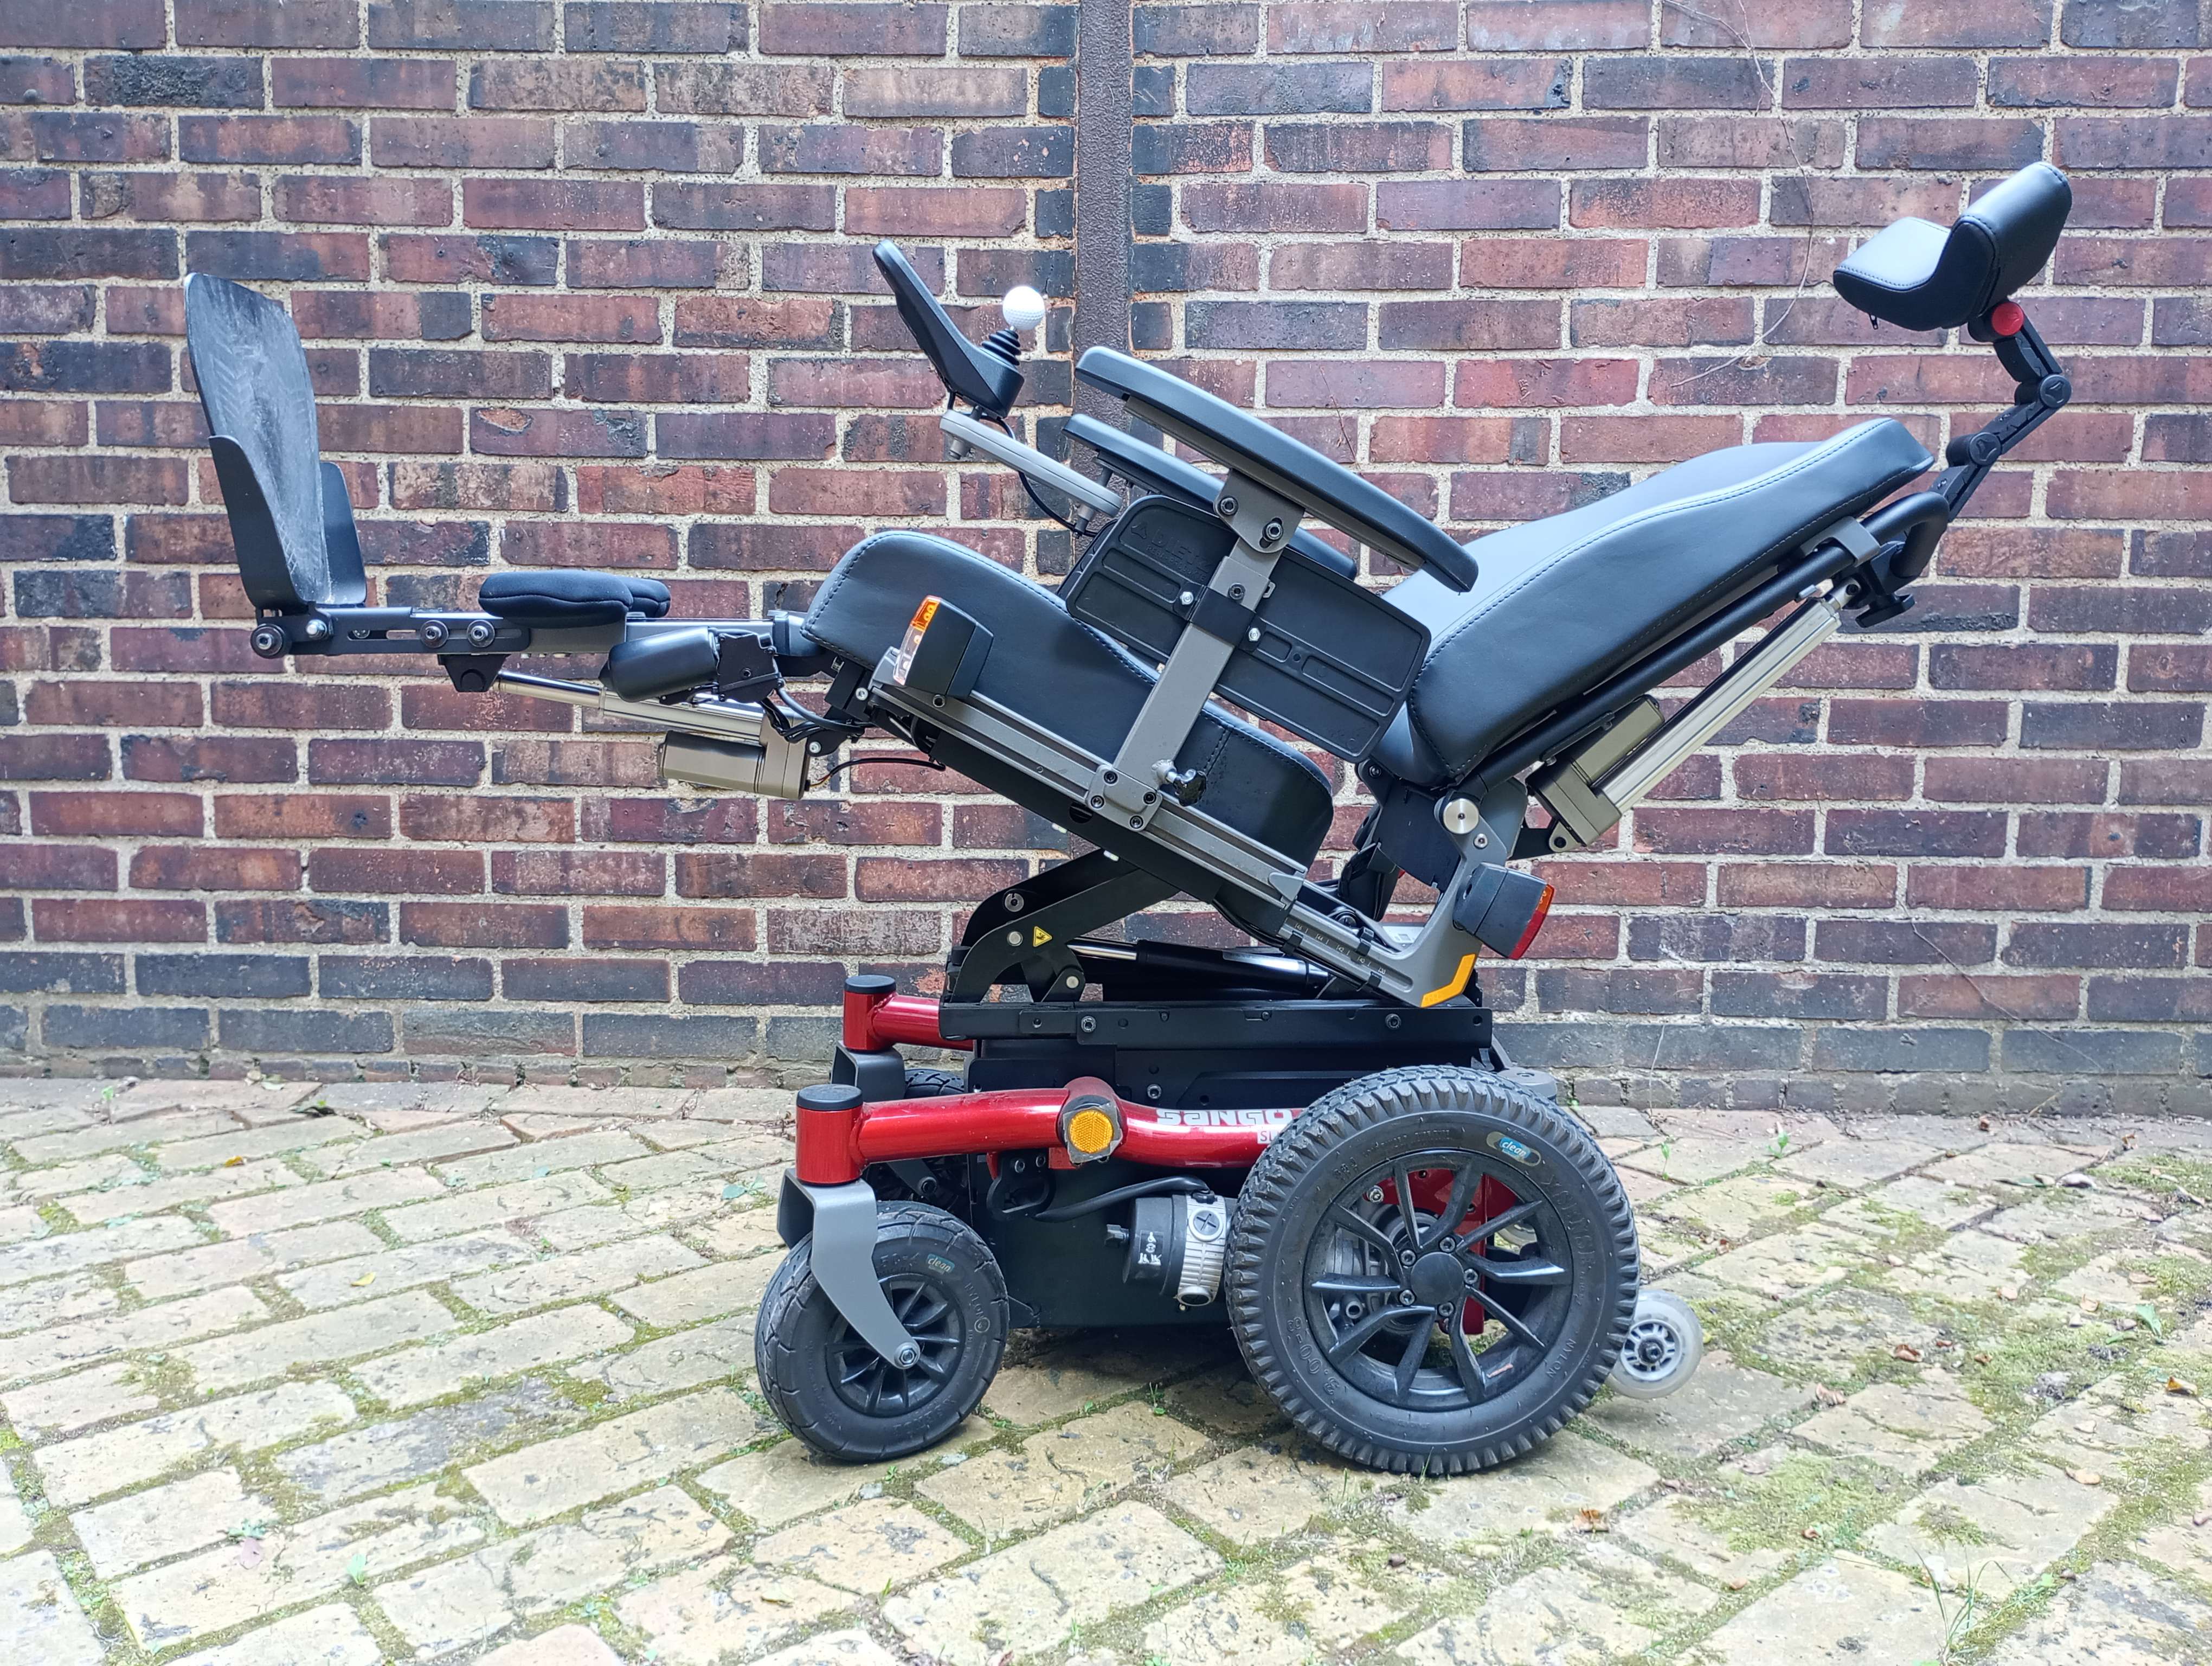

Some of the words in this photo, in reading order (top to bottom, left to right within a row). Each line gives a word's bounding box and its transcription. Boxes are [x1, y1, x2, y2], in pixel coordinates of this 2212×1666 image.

[1502, 1141, 1527, 1158] clean
[928, 1257, 951, 1272] clean
[1545, 1338, 1578, 1378] NYLON
